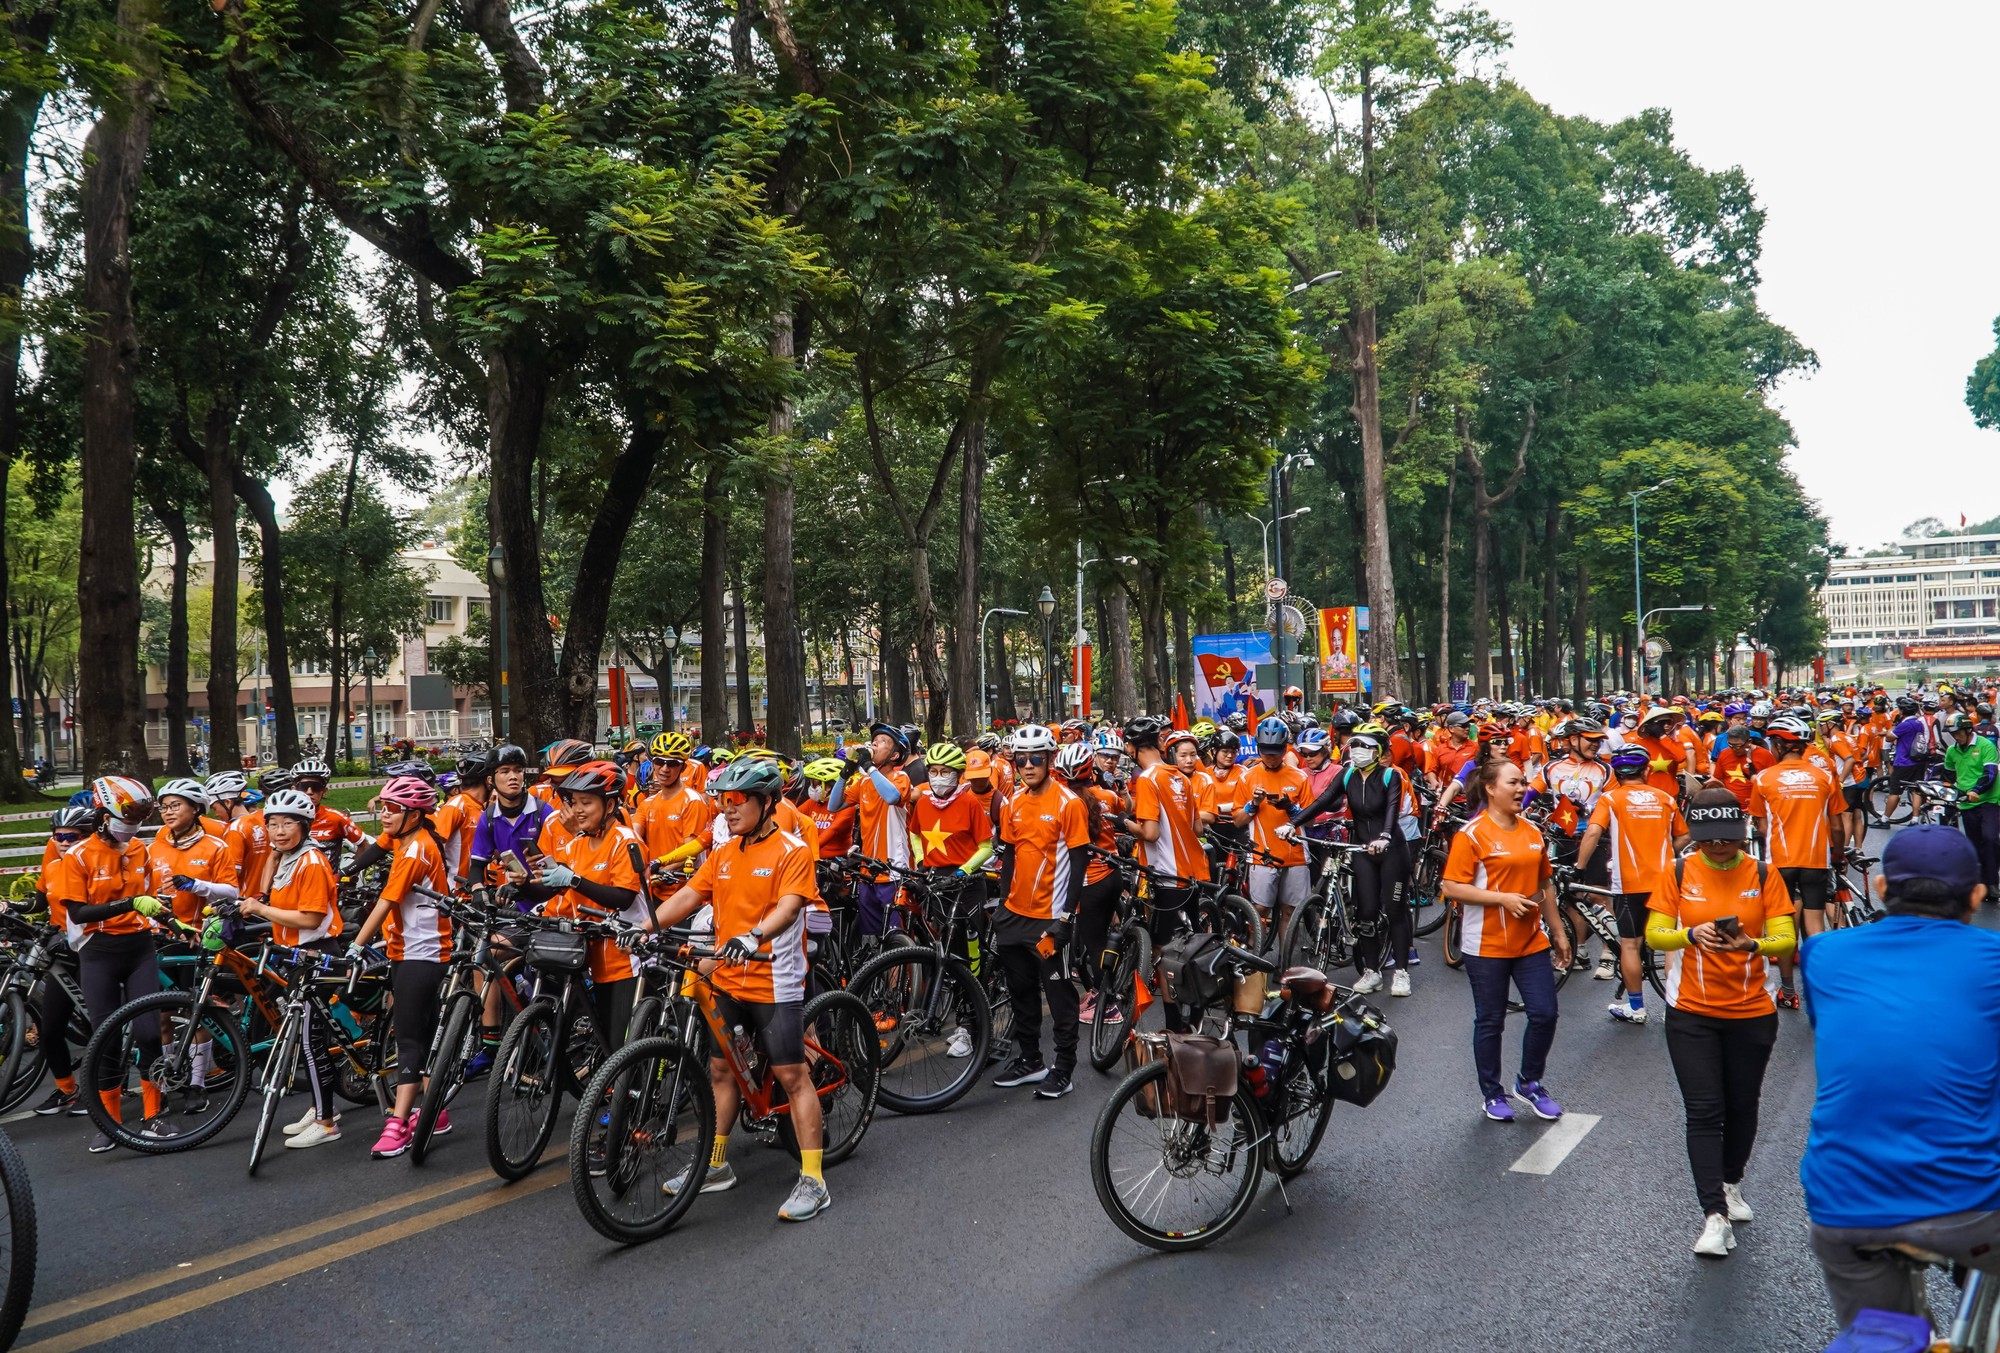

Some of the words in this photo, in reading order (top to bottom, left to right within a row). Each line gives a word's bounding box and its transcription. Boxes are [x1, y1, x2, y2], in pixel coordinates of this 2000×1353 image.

[1691, 807, 1740, 820] SPORT
[1576, 901, 1616, 941] GIANT
[311, 996, 356, 1051] SCOTT
[868, 1072, 880, 1111] HUTCHINSON
[131, 1137, 154, 1146] COMP
